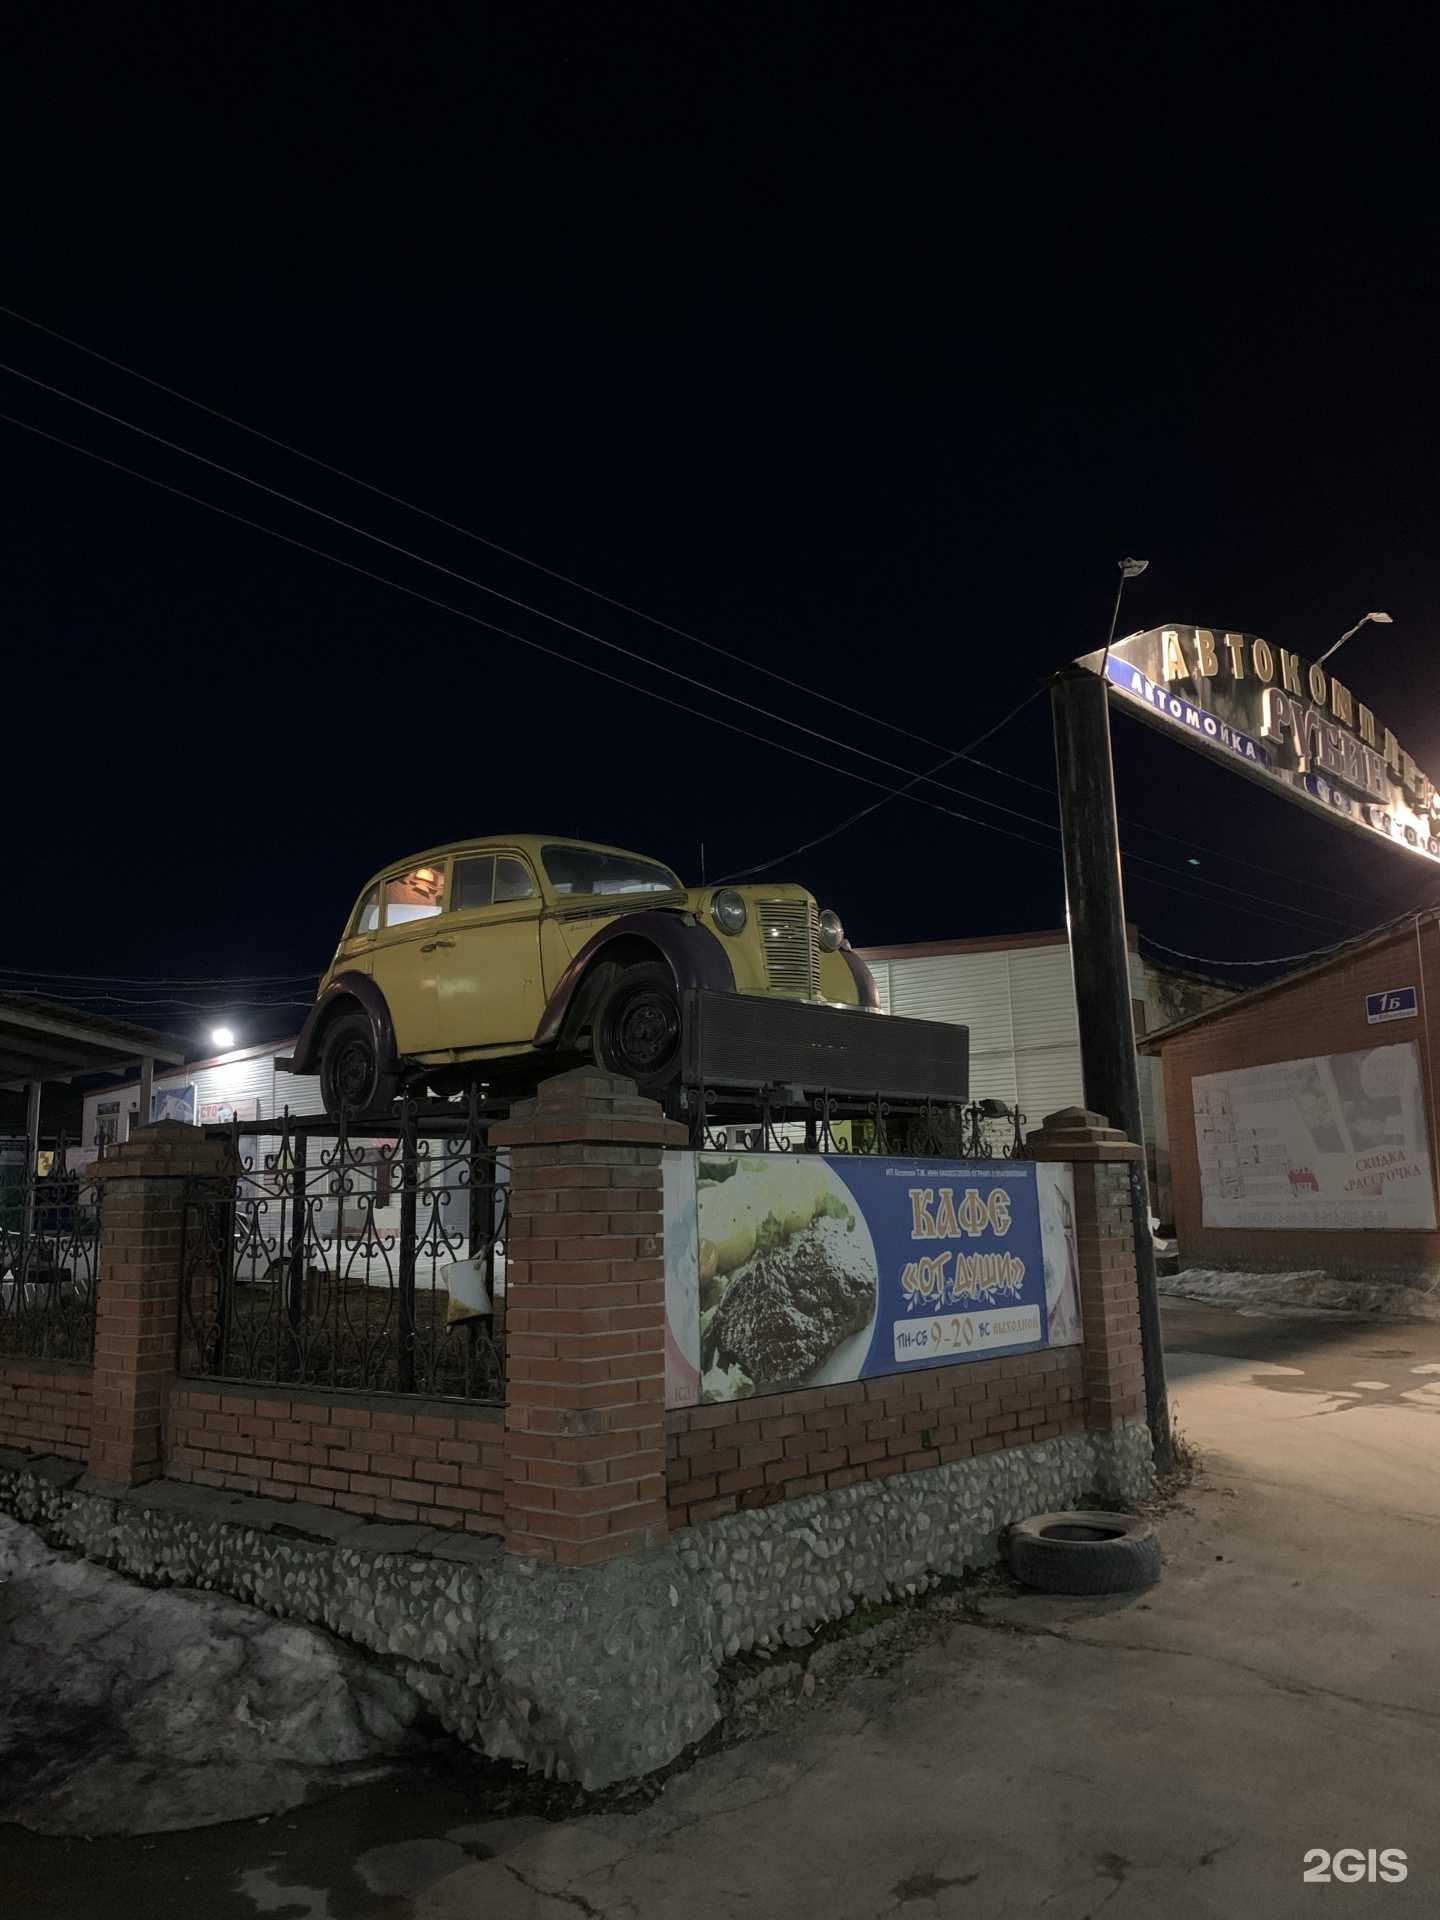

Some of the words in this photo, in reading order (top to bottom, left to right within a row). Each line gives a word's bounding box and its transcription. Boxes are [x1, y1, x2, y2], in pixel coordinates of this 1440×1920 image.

[1261, 687, 1392, 805] РУБИН
[1355, 1150, 1406, 1171] СКИДКА
[909, 1187, 1012, 1240] КАФЕ
[977, 1321, 991, 1338] ВС
